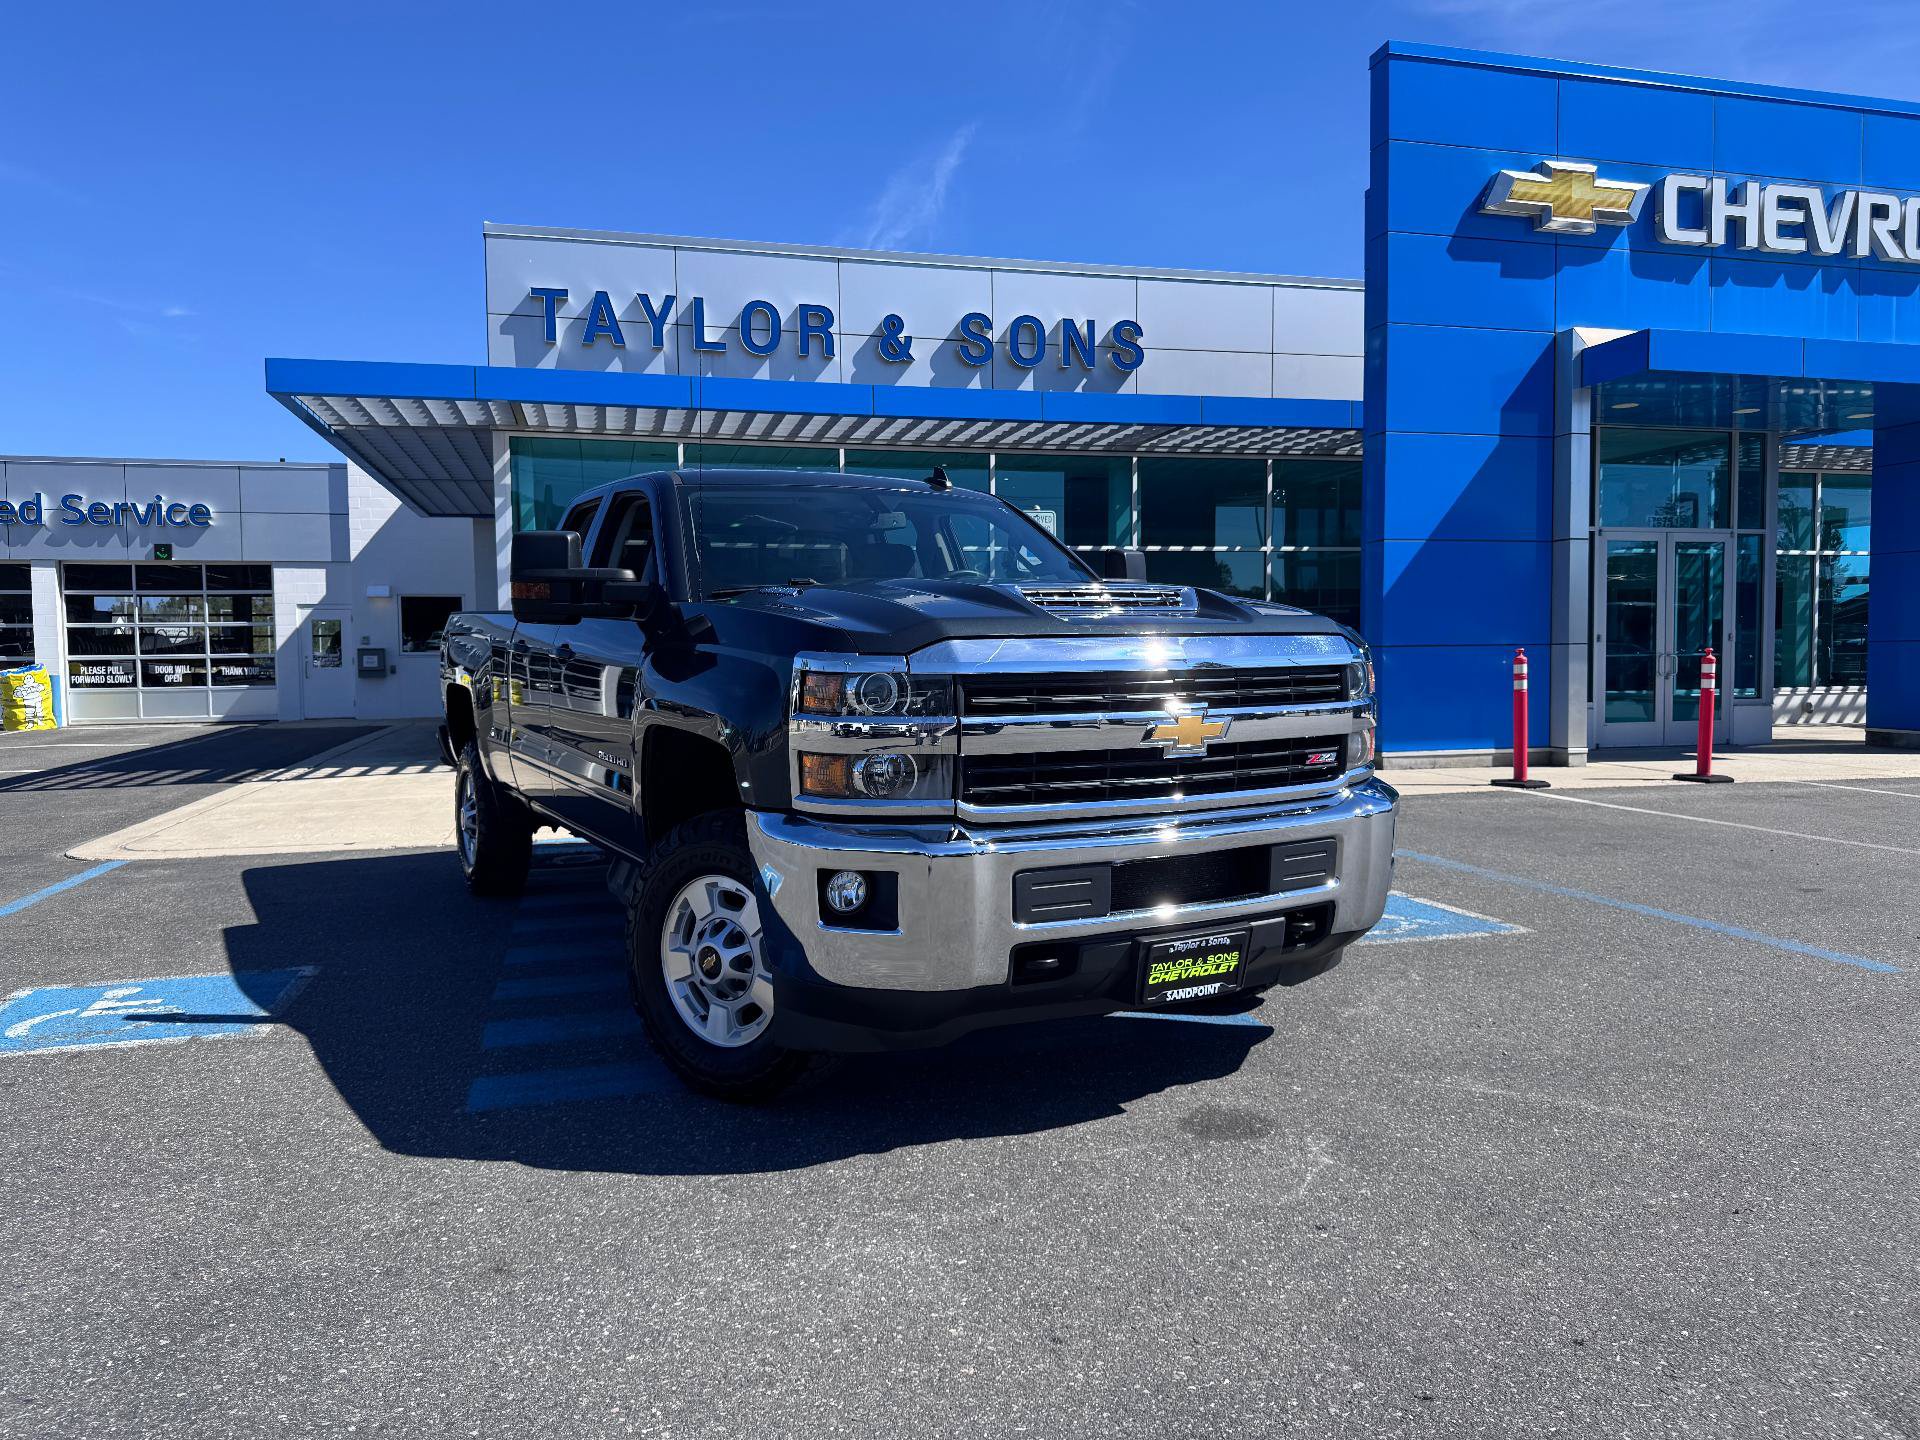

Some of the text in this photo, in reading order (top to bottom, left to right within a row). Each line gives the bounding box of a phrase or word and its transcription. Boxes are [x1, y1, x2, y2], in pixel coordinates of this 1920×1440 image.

[529, 286, 1146, 373] TAYLOR & SONS
[60, 493, 214, 528] Service
[80, 666, 125, 675] PLEASE PULL
[154, 665, 192, 674] DOOR WILL
[221, 666, 244, 675] THANK
[71, 674, 133, 684] FORWARD SLOWLY
[164, 674, 183, 683] OPEN
[1174, 941, 1200, 953] Taylor
[1151, 952, 1240, 971] TAYLOR & SONS
[1148, 963, 1239, 985] CHEVROLET
[1166, 983, 1221, 1001] SANDPOINT
